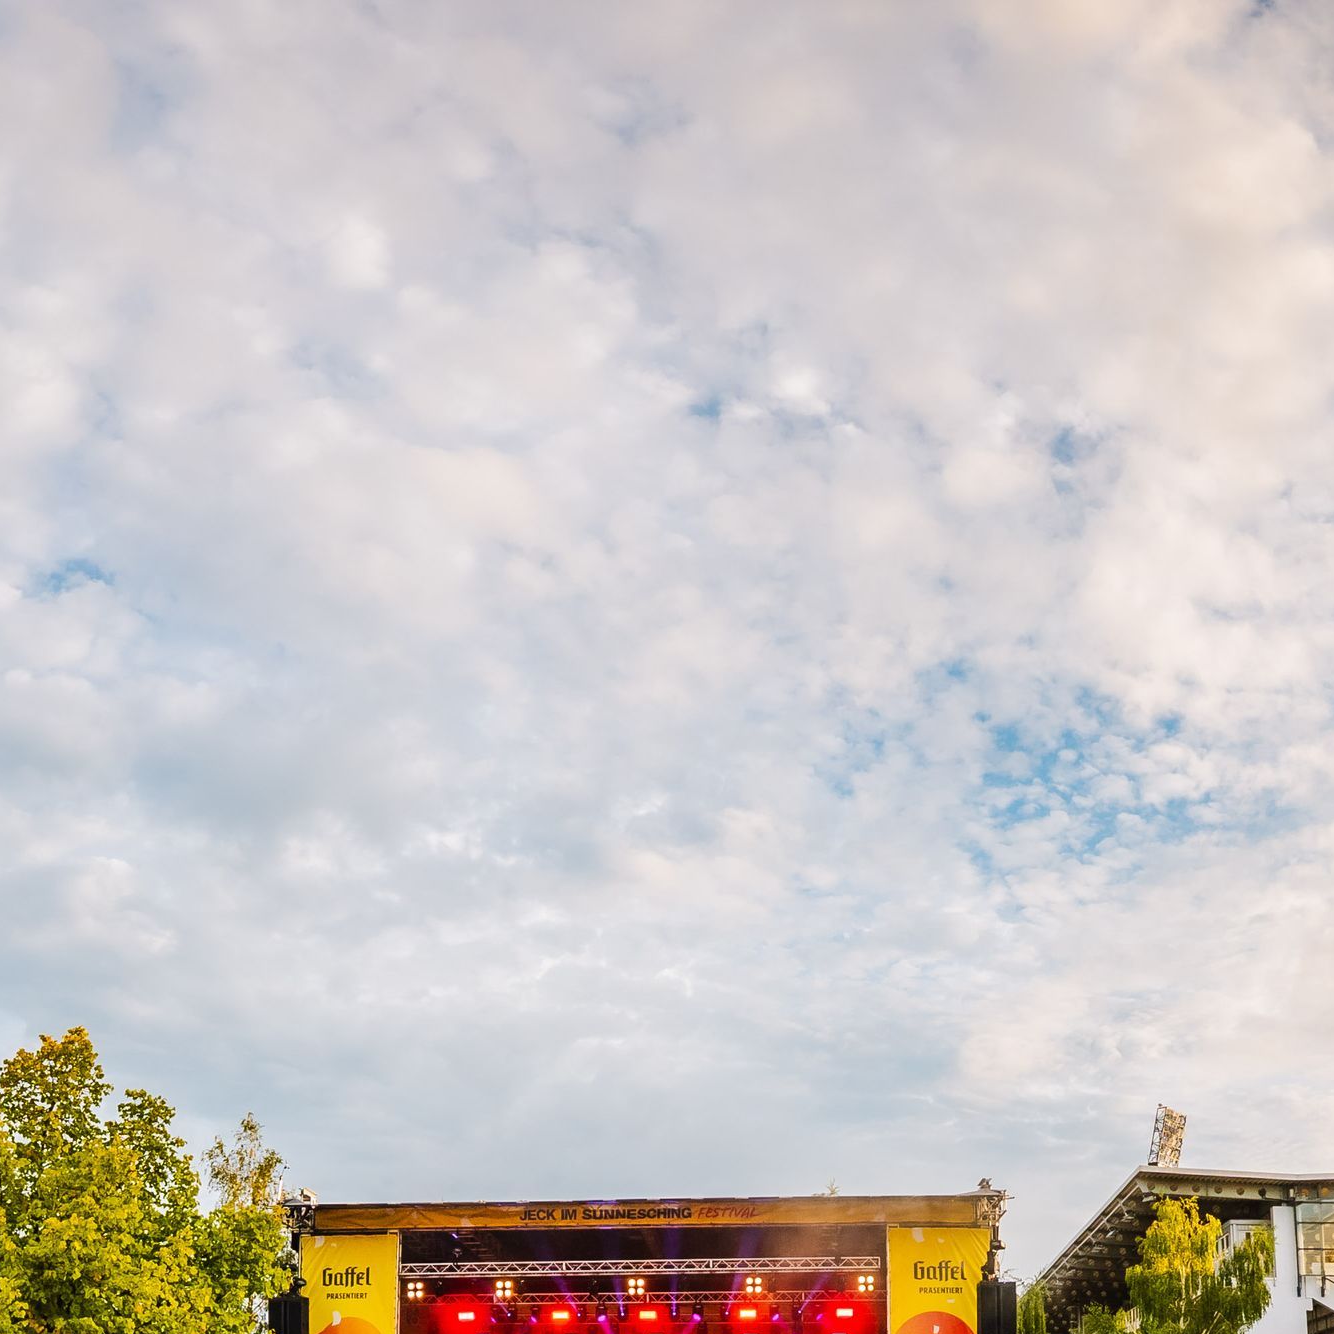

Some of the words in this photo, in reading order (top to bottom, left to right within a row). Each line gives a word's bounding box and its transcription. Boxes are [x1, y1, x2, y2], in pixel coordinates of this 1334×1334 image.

[520, 1209, 556, 1220] JECK
[560, 1208, 577, 1220] IM
[697, 1206, 762, 1218] FESTIVAL
[322, 1266, 371, 1287] Gaffel
[913, 1260, 967, 1281] Gaffel
